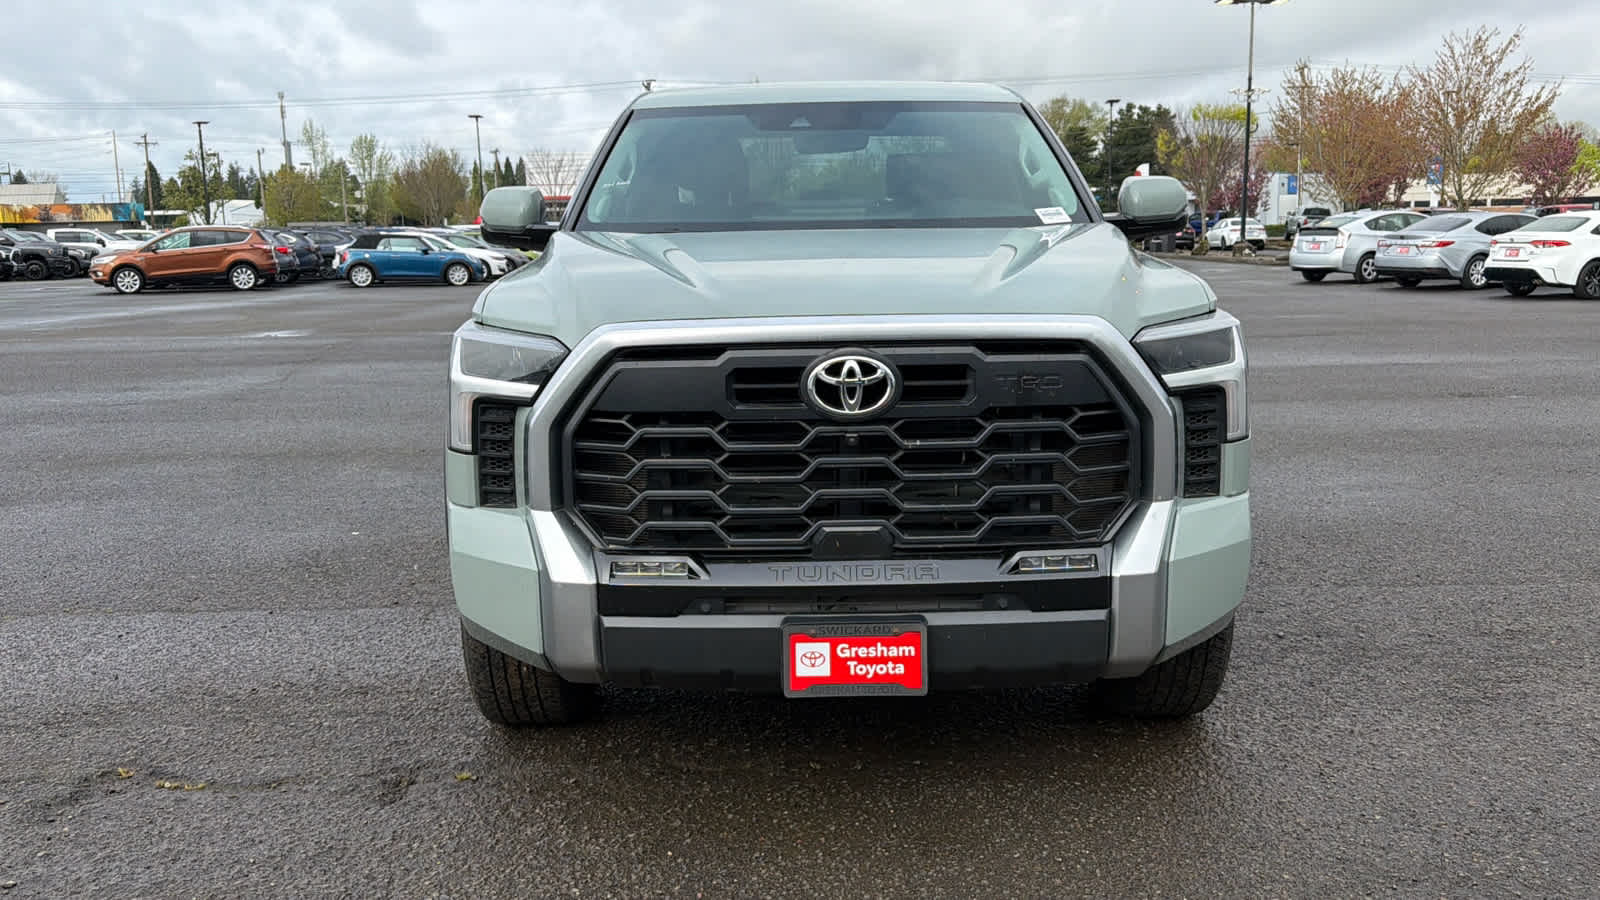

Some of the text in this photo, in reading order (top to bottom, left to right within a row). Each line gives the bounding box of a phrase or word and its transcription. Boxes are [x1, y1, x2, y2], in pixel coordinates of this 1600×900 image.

[768, 563, 941, 583] TUNDRA
[818, 624, 894, 635] SWICKARD
[836, 642, 915, 658] Gresham
[847, 661, 905, 679] Toyota
